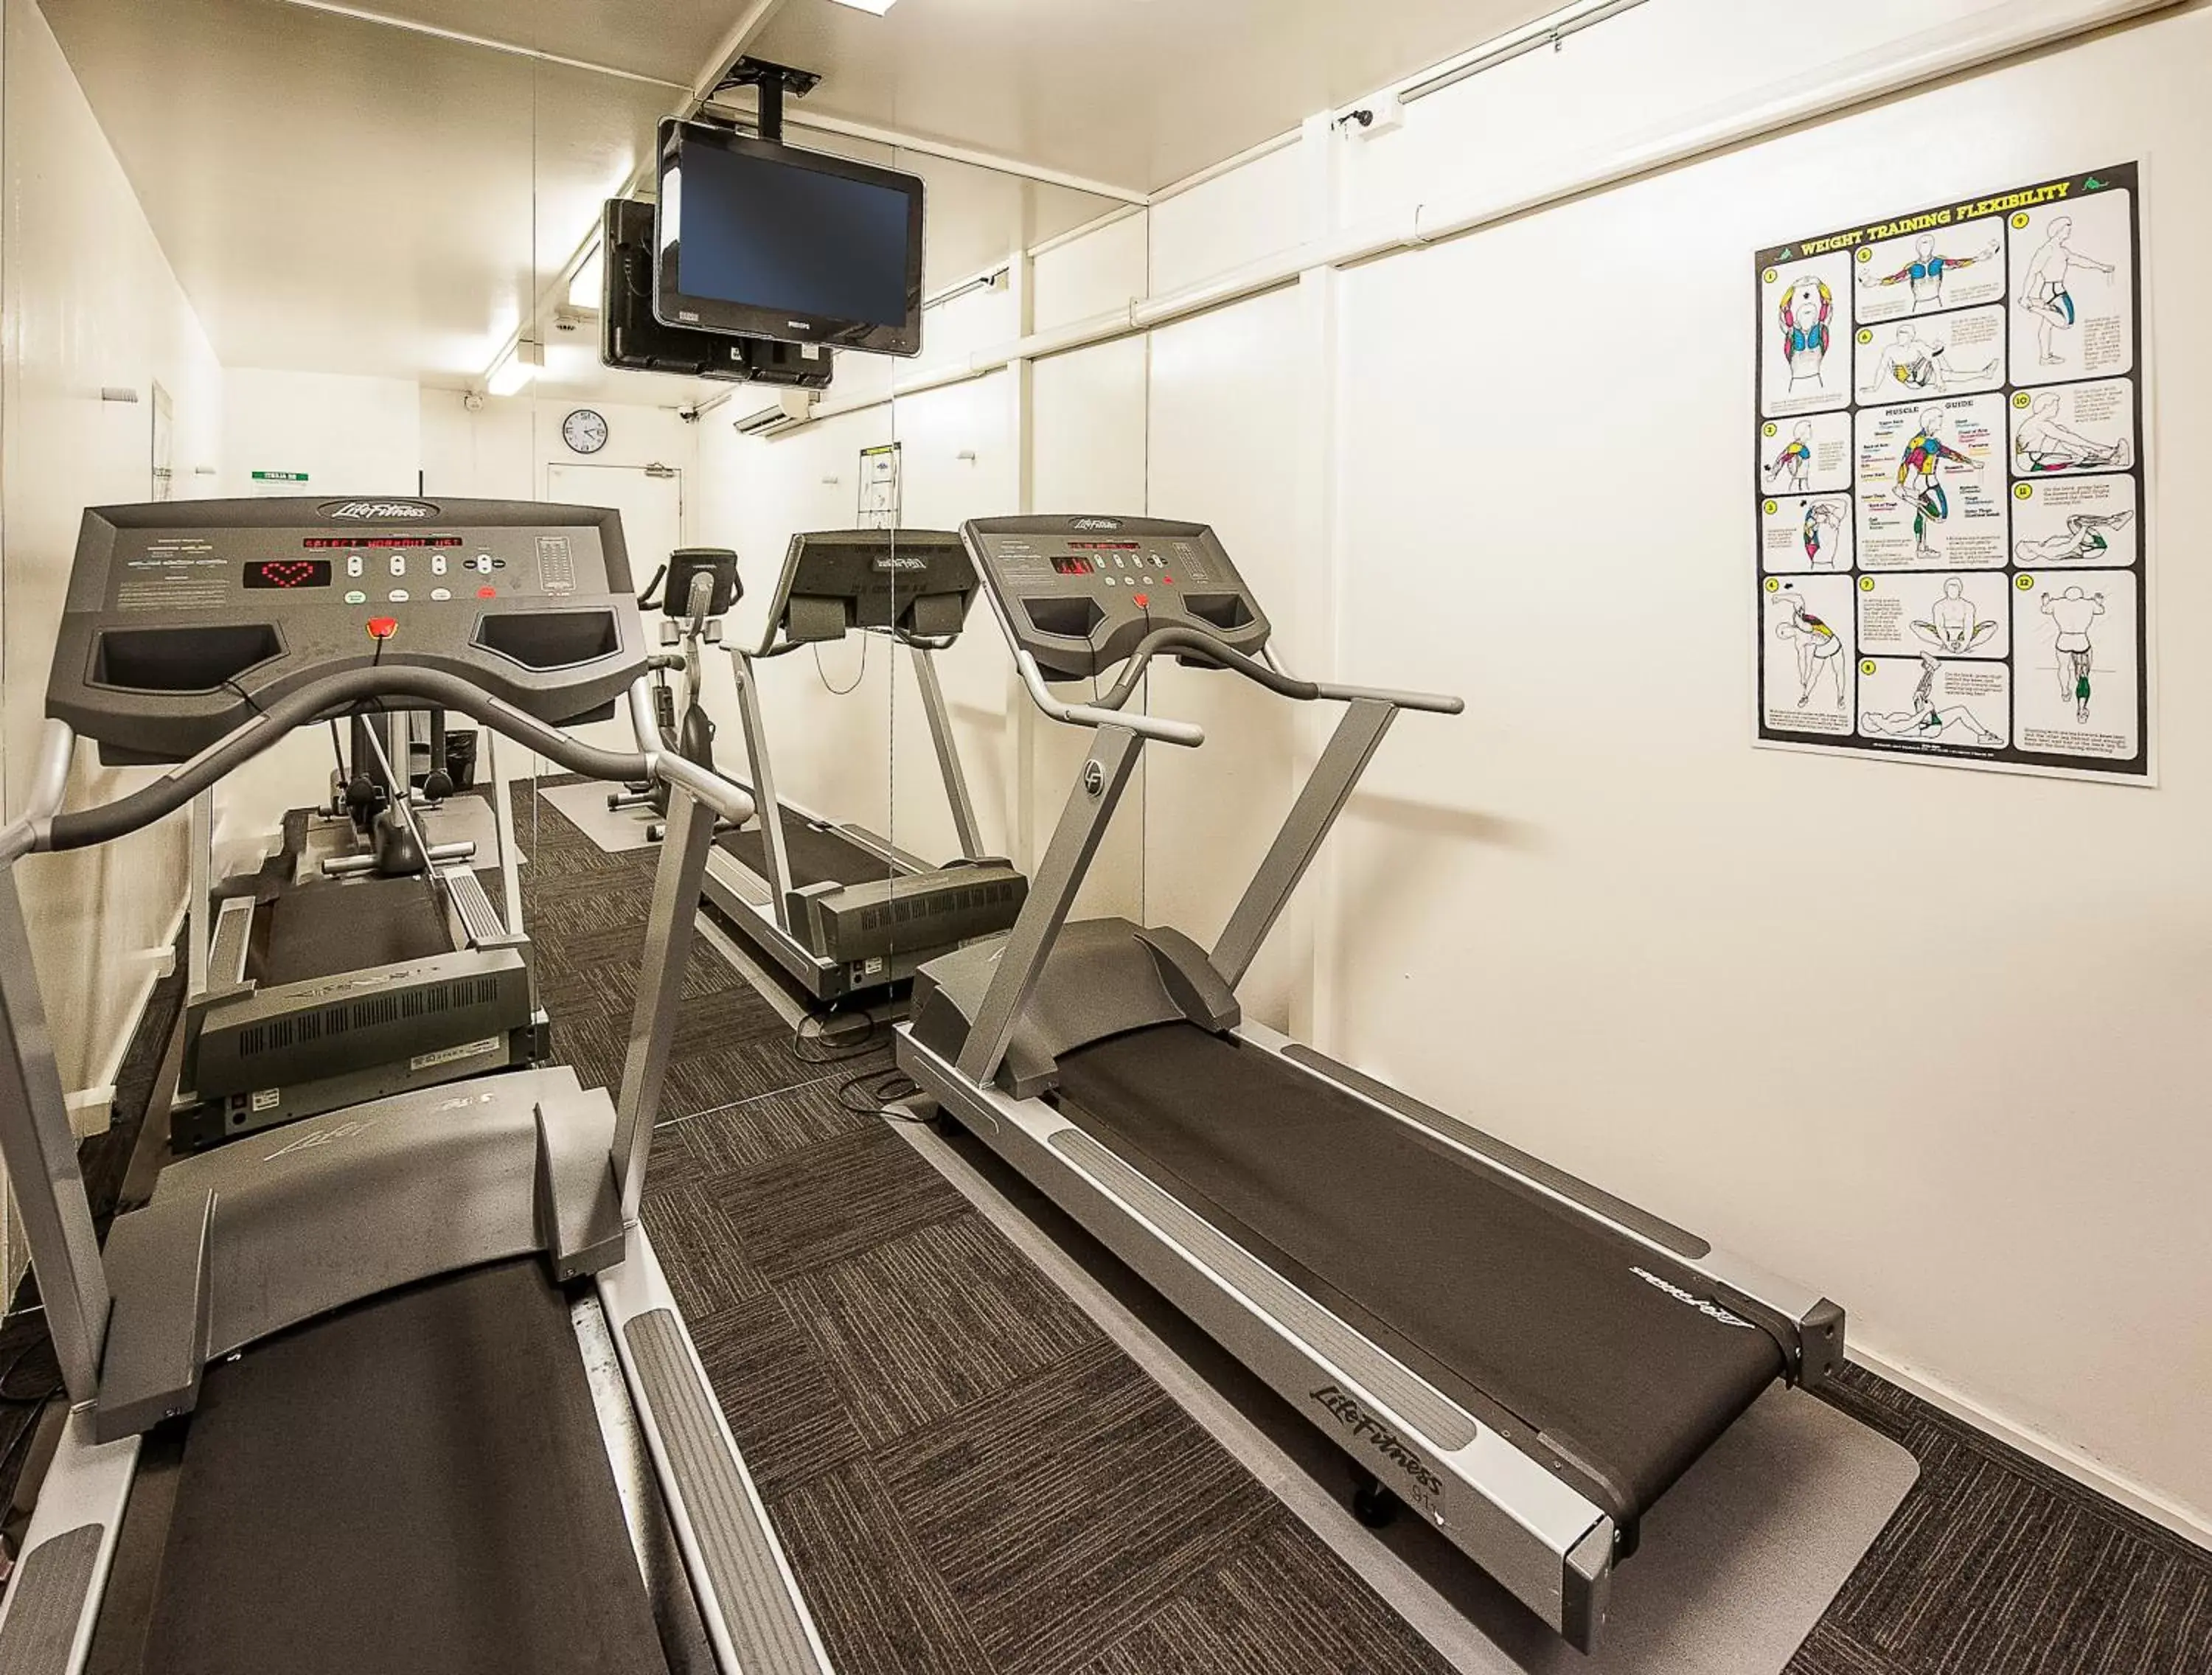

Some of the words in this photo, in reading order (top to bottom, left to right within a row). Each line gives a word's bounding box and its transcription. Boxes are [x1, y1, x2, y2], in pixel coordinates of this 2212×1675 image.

[1801, 231, 1863, 257] WEIGHT
[1867, 211, 1951, 241] TRAINING
[1956, 182, 2070, 220] FLEXIBILITY
[1885, 406, 1919, 416] MUSCLE
[1944, 400, 1975, 408] GUIDE
[2017, 396, 2027, 405] 10
